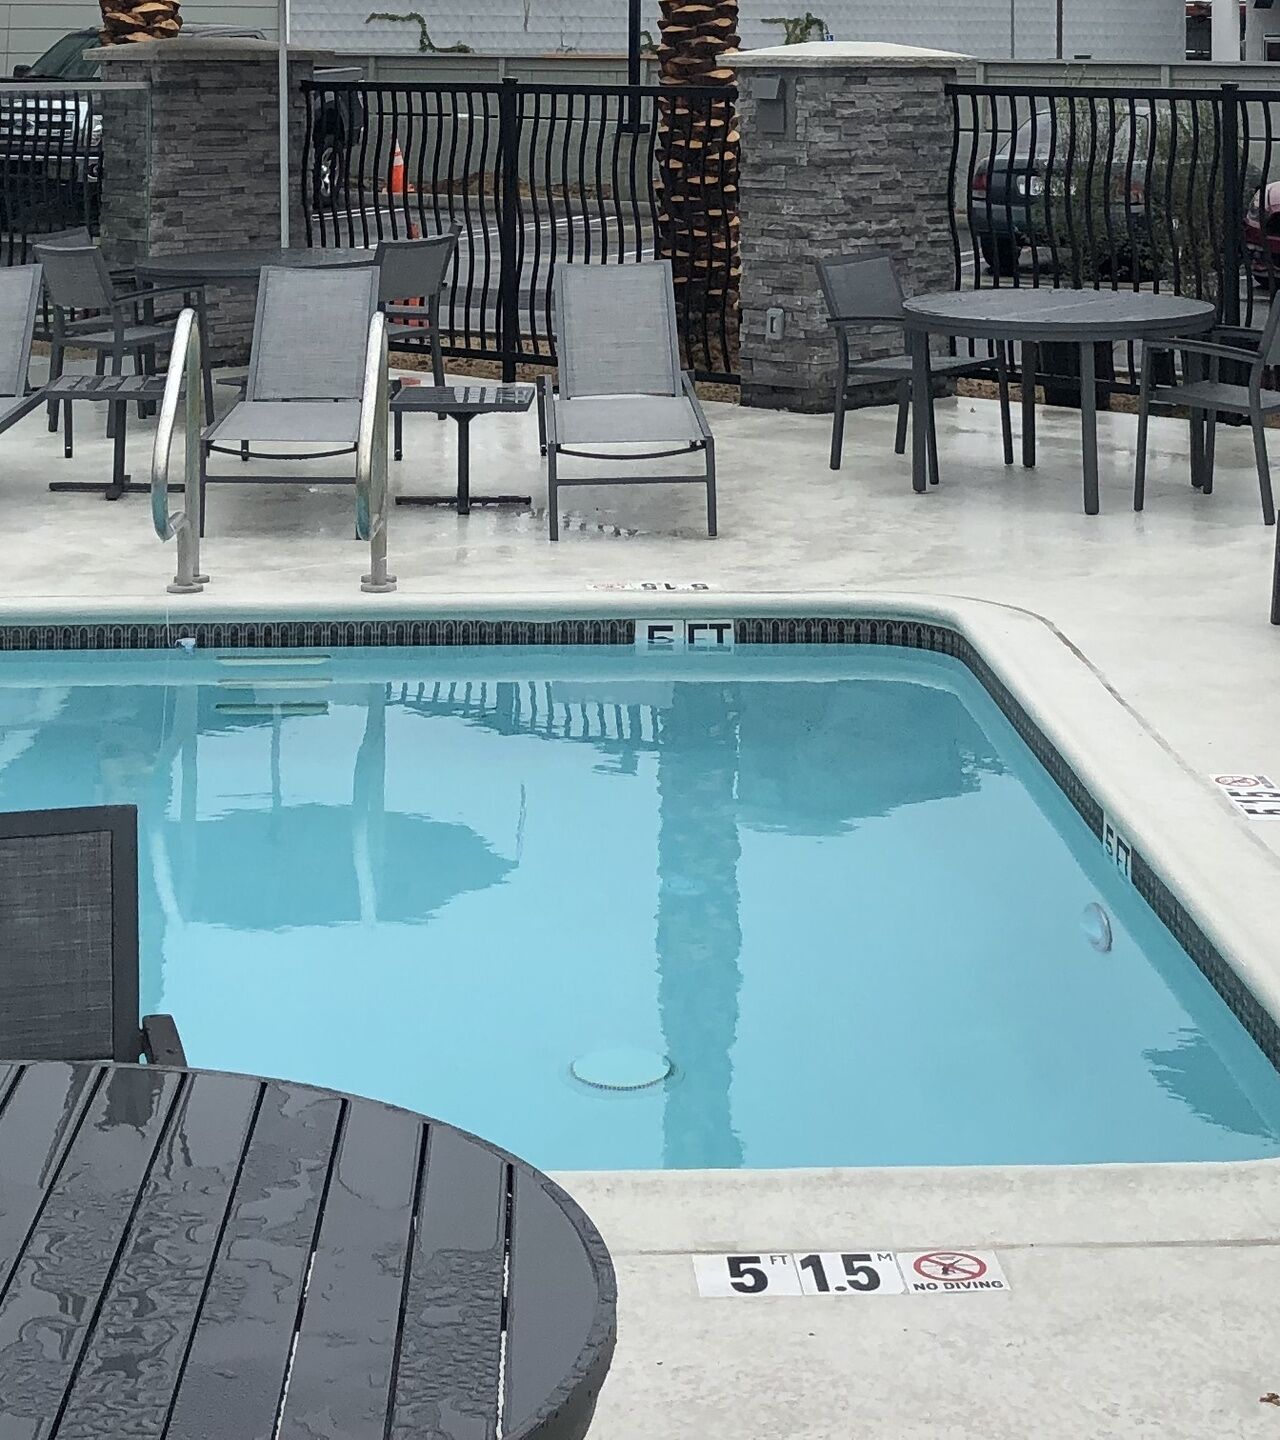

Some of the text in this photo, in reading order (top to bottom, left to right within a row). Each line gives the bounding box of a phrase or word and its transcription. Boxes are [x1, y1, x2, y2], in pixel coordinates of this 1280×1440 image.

[687, 623, 732, 644] FT
[1105, 823, 1114, 857] 5
[726, 1253, 893, 1294] 5 FT 1.5 M
[913, 1280, 1004, 1291] NO DIVING
